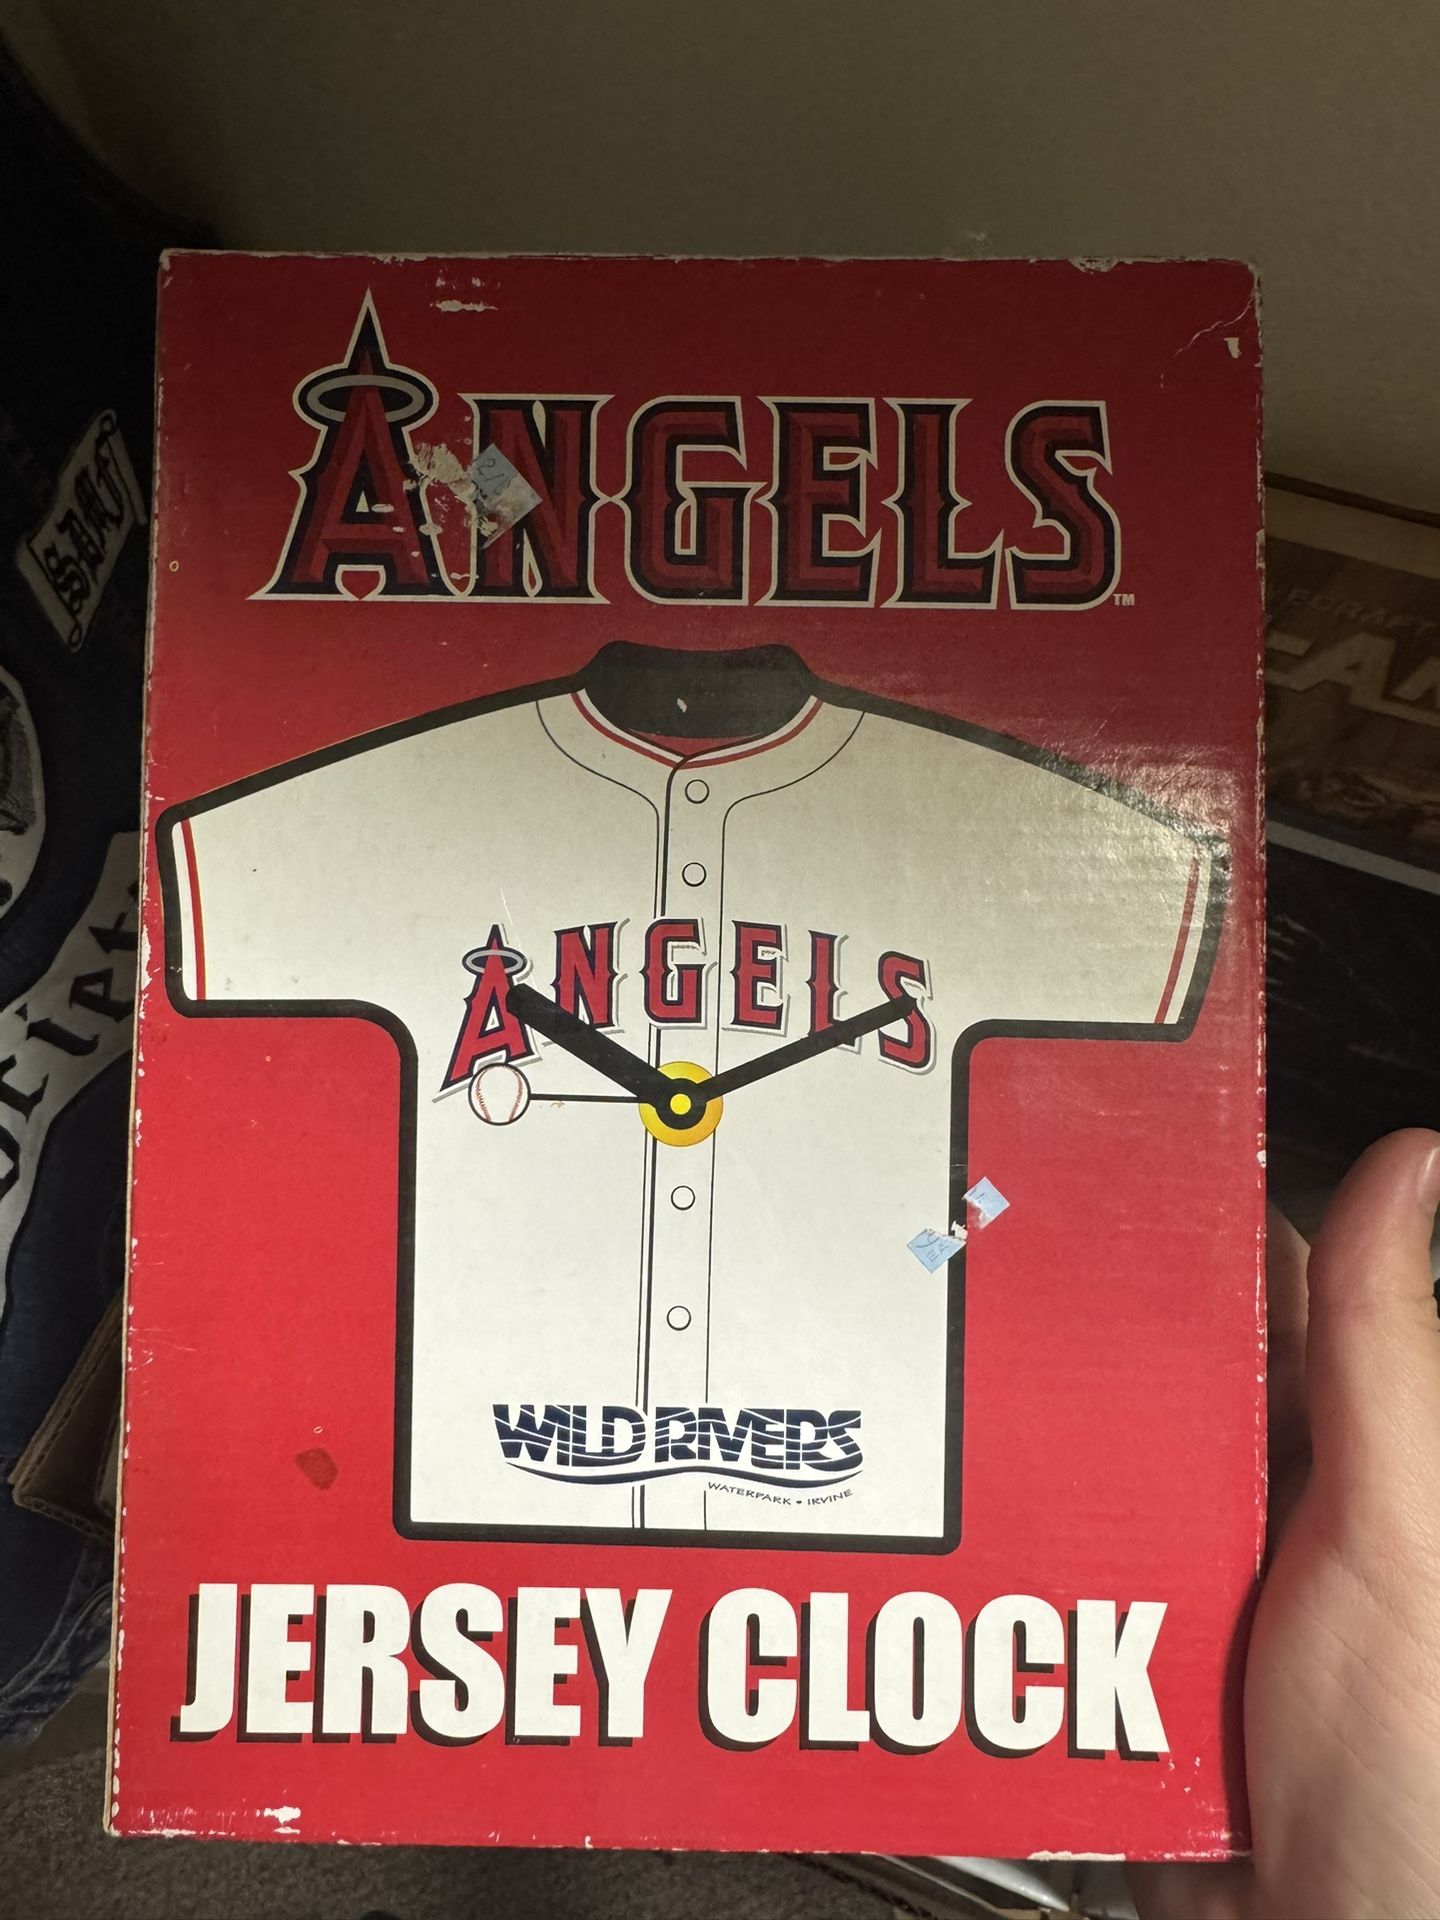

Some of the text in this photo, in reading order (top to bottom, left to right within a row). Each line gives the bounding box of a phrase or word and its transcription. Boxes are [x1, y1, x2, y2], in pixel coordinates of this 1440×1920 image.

[246, 288, 1135, 610] ANGELS TM
[433, 917, 937, 1101] ANGELS
[492, 1403, 863, 1472] WILD RIVERS
[708, 1481, 853, 1506] WATERPARK IRVINE
[173, 1581, 1170, 1758] JERSEY CLOCK
